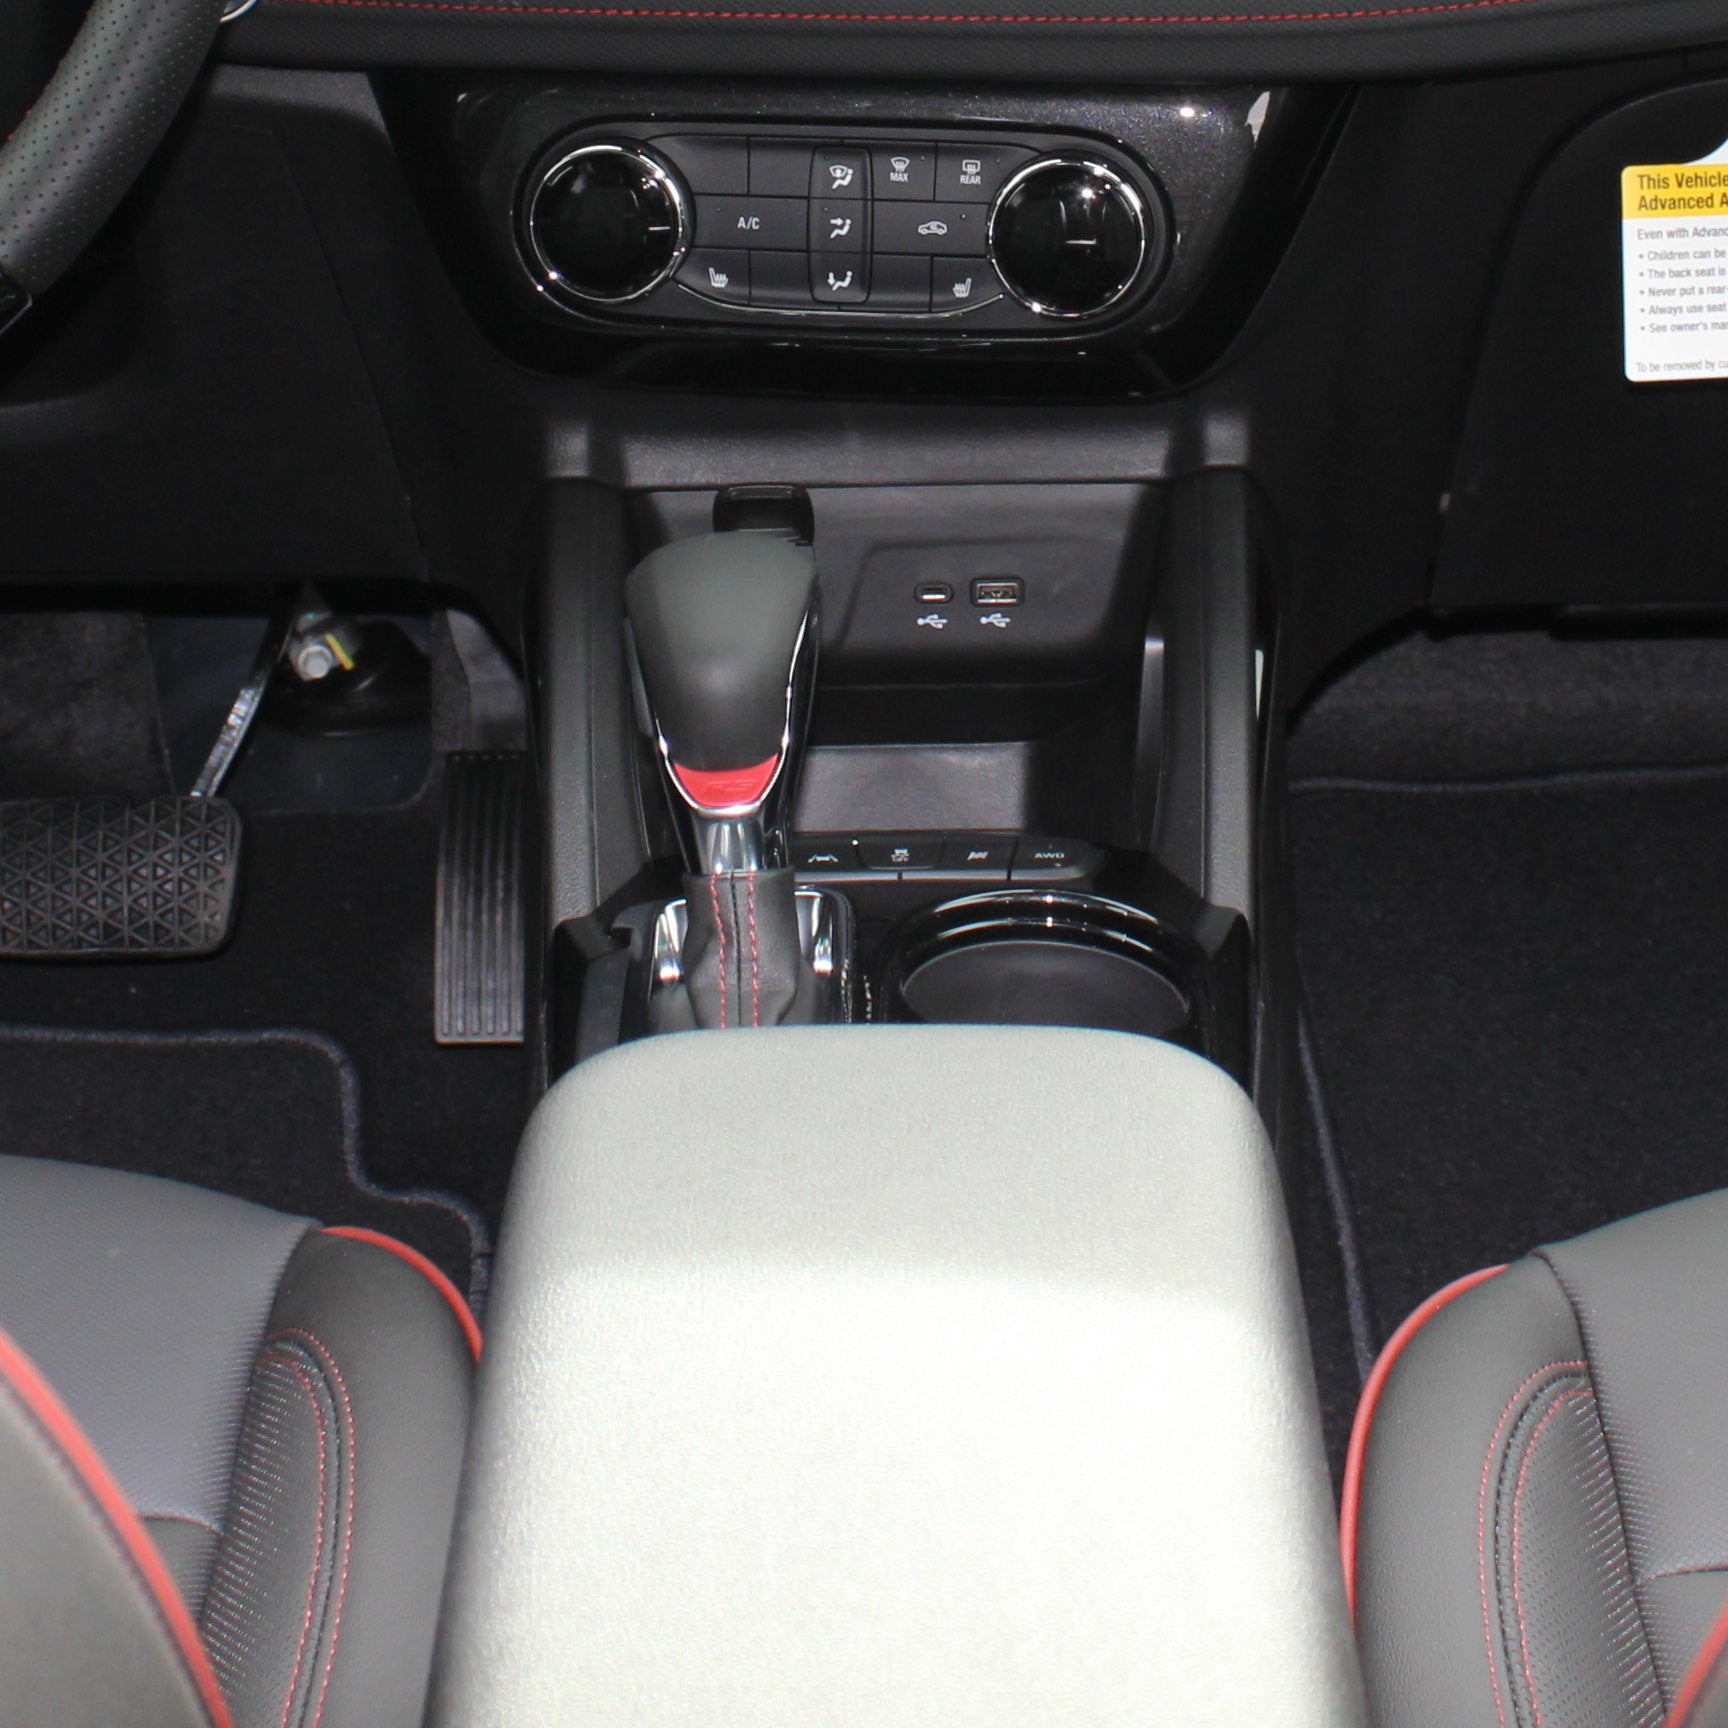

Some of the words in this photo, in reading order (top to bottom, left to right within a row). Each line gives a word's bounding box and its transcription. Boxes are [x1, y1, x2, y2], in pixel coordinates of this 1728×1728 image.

[889, 172, 910, 183] MAX
[960, 174, 982, 185] REAR
[1637, 174, 1670, 190] This
[1638, 194, 1714, 211] Advanced
[737, 216, 760, 230] A/C
[1637, 229, 1663, 240] Even
[1667, 228, 1689, 239] with
[1647, 250, 1690, 261] Children
[1693, 250, 1711, 259] can
[1714, 248, 1727, 258] be
[1648, 269, 1666, 279] The
[1669, 267, 1692, 278] back
[1695, 267, 1715, 277] seat
[1718, 266, 1726, 276] is
[1648, 287, 1677, 297] Never
[1680, 286, 1695, 297] put
[1649, 304, 1683, 316] Always
[1686, 305, 1703, 313] use
[1706, 302, 1726, 312] seat
[1649, 323, 1667, 333] See
[1670, 322, 1708, 332] owner's
[1636, 362, 1647, 372] To
[1649, 361, 1661, 371] be
[1663, 359, 1703, 370] removed
[1705, 359, 1715, 371] by
[701, 778, 757, 792] RS
